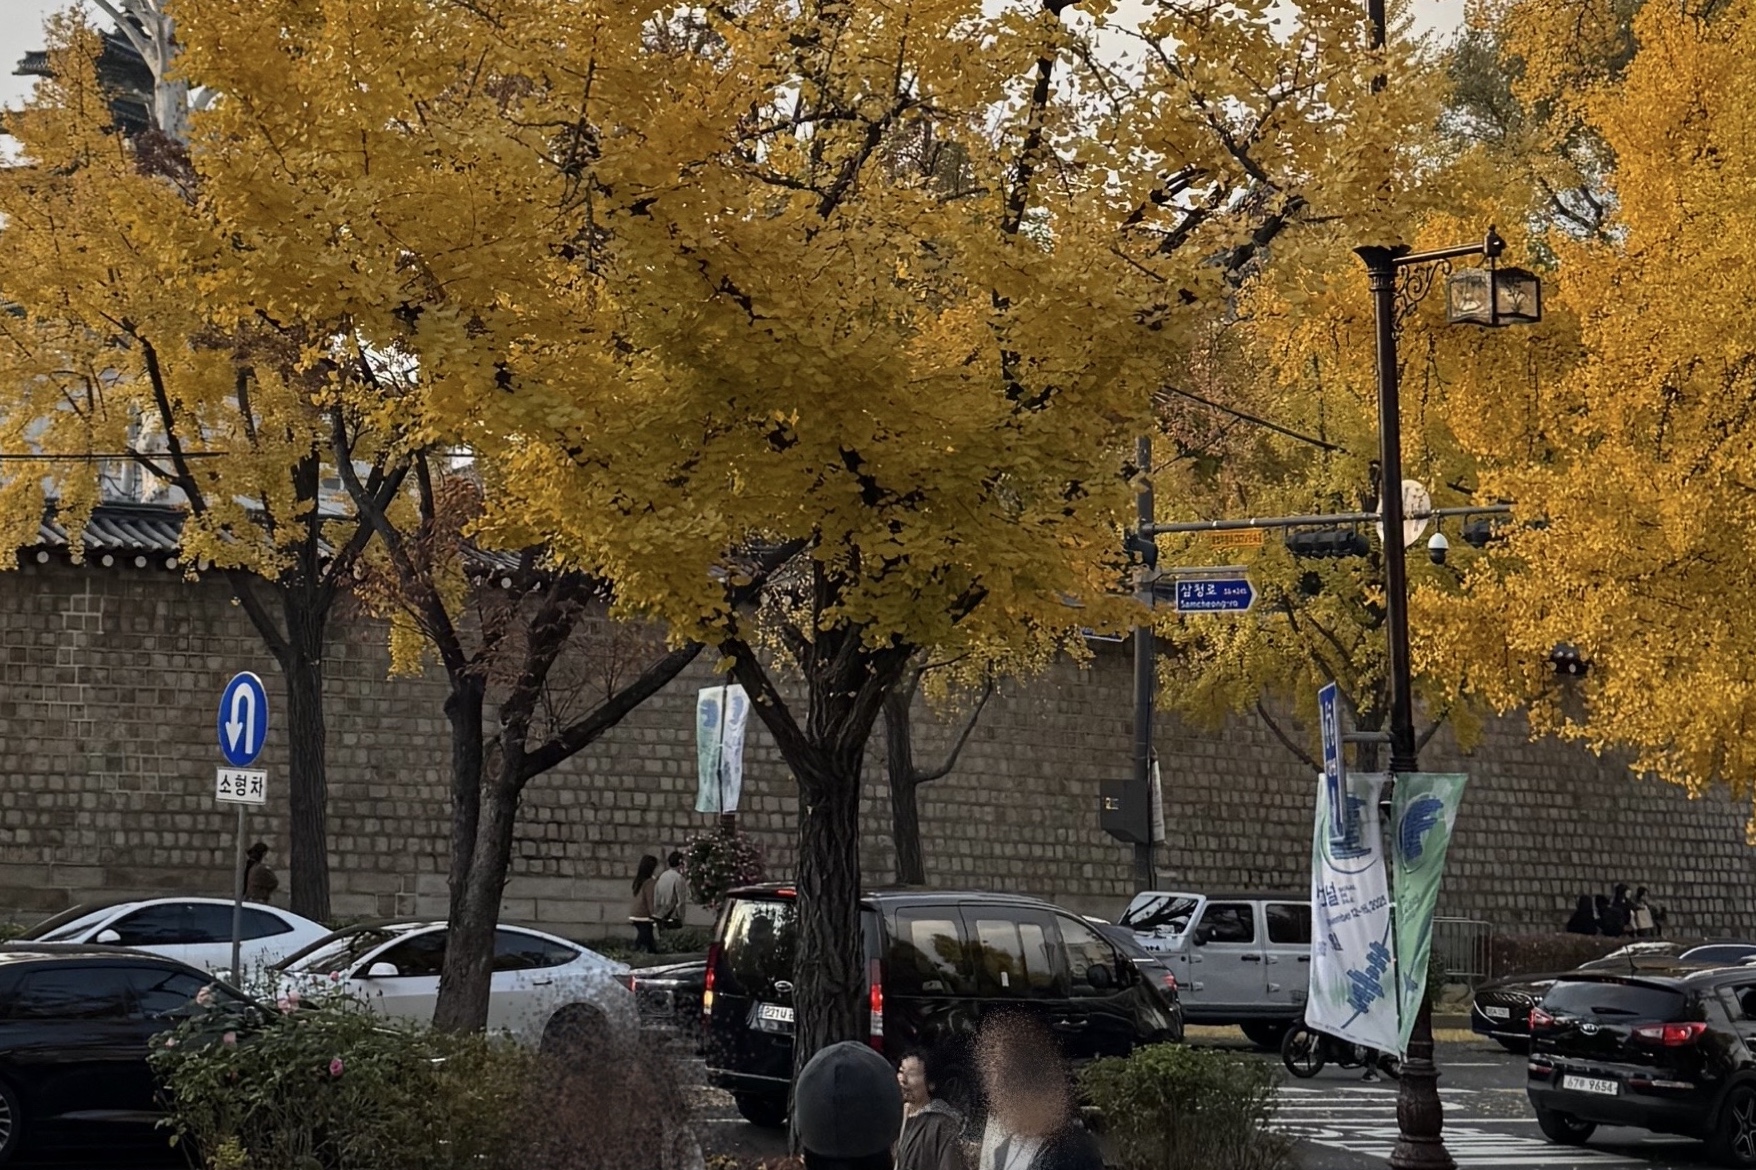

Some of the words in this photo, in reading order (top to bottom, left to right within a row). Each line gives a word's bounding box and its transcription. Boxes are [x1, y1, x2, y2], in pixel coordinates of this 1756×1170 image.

[1181, 584, 1217, 598] 삼청로
[219, 774, 263, 797] 소형차
[1589, 1080, 1613, 1092] 9654
